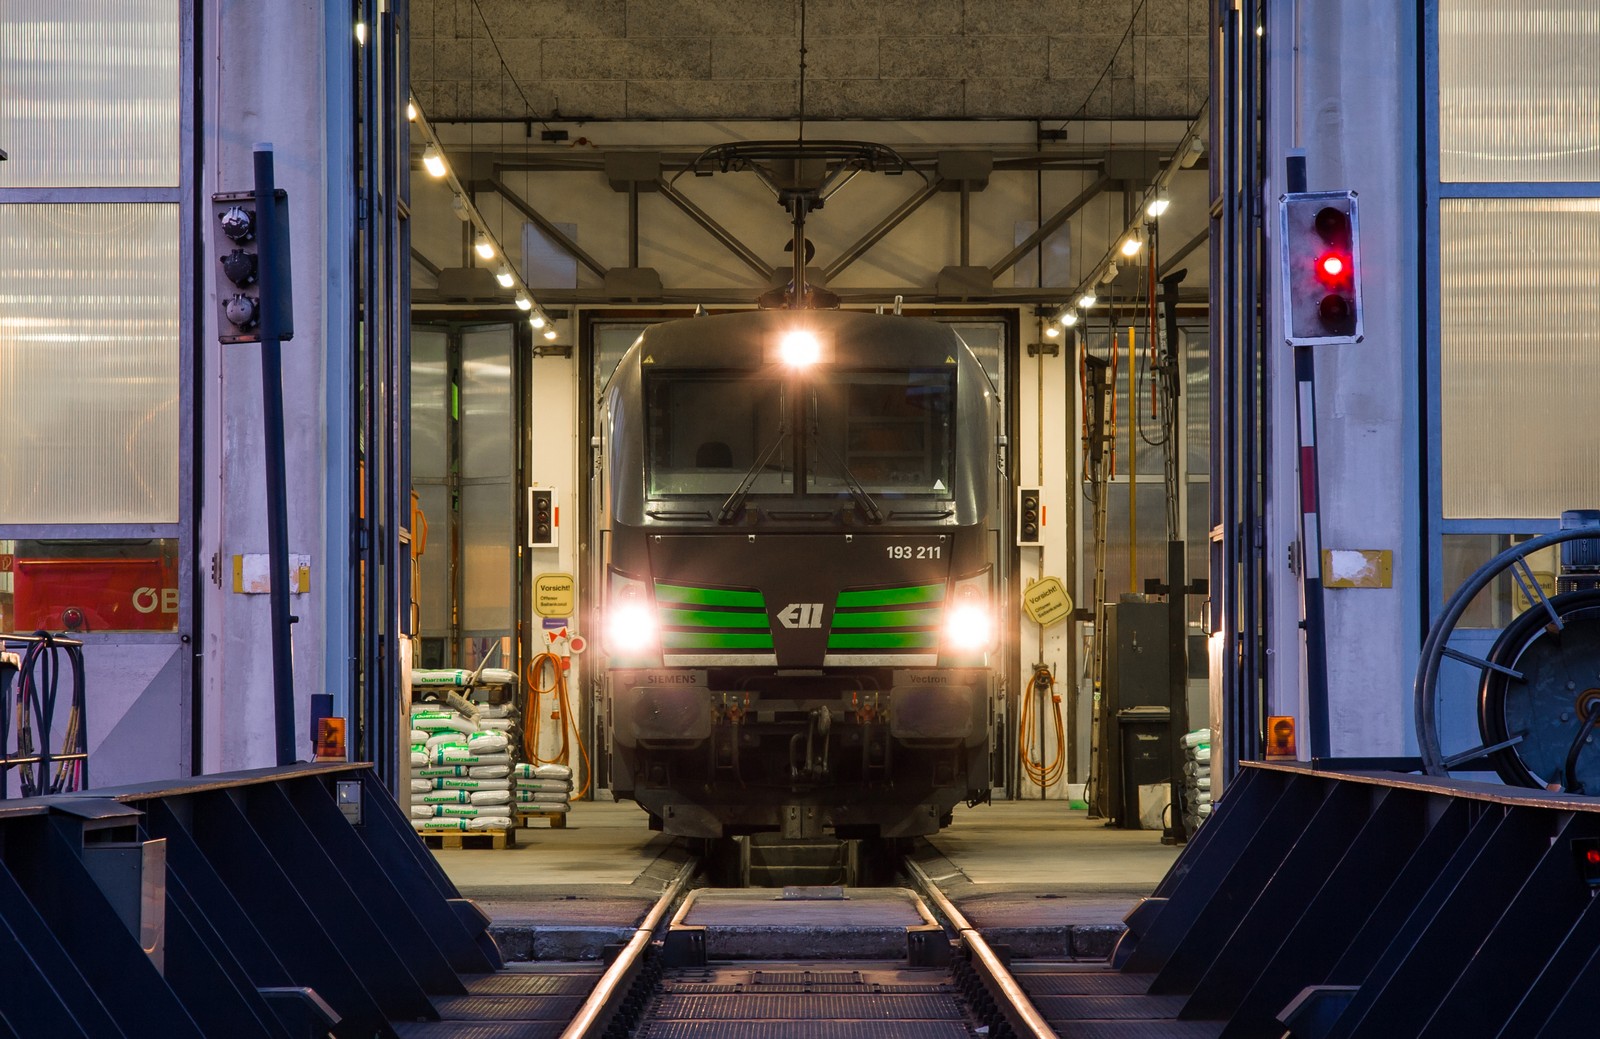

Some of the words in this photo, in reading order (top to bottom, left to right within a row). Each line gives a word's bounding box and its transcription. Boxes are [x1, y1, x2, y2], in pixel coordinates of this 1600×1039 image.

[886, 546, 912, 559] 193
[916, 546, 941, 559] 211
[1029, 586, 1058, 604] Vorsicht!
[647, 675, 696, 684] SIEMENS
[910, 674, 947, 684] Vectron
